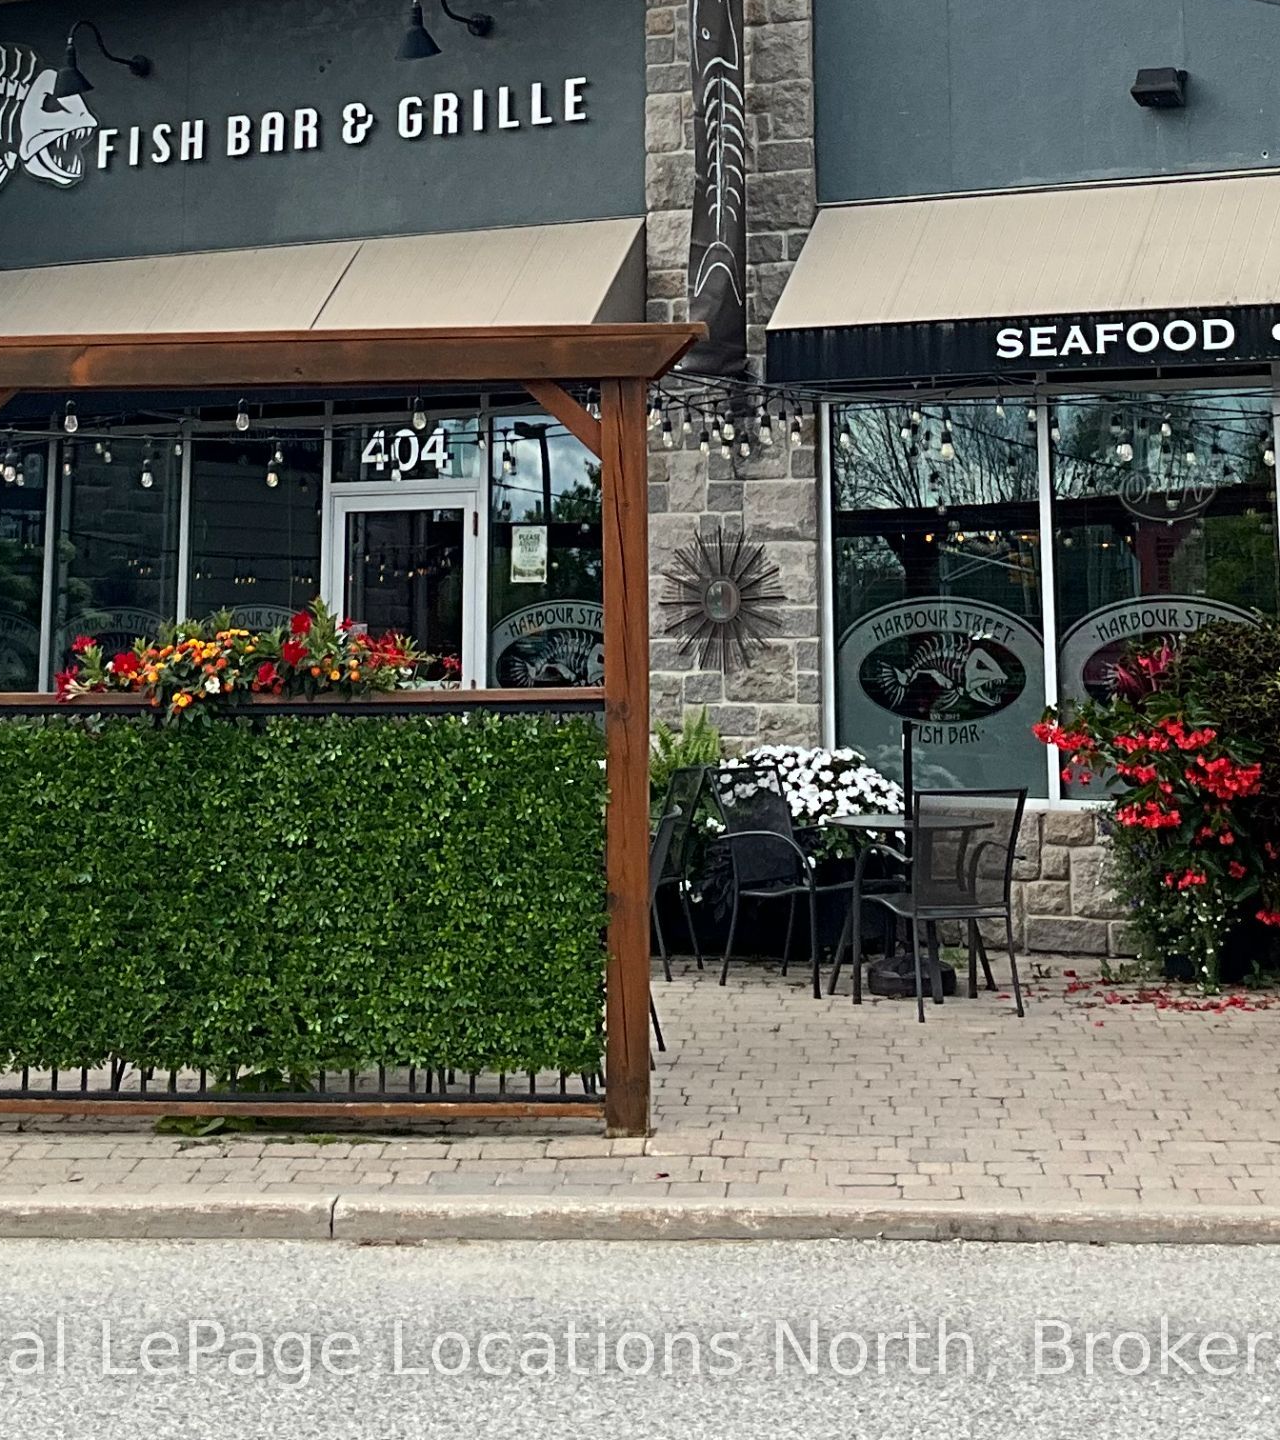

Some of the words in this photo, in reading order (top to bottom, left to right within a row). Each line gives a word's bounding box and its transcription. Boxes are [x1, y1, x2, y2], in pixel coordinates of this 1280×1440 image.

[97, 119, 204, 170] FISH
[228, 107, 318, 157] BAR
[342, 102, 374, 145] &
[398, 76, 588, 140] GRILLE
[996, 318, 1235, 359] SEAFOOD
[361, 427, 449, 472] 404
[508, 608, 574, 637] HARBOUR
[577, 608, 604, 628] STR
[872, 609, 948, 641] HARBOUR
[1096, 609, 1179, 642] HARBOUR
[1184, 610, 1228, 629] STR
[948, 723, 980, 744] BAR
